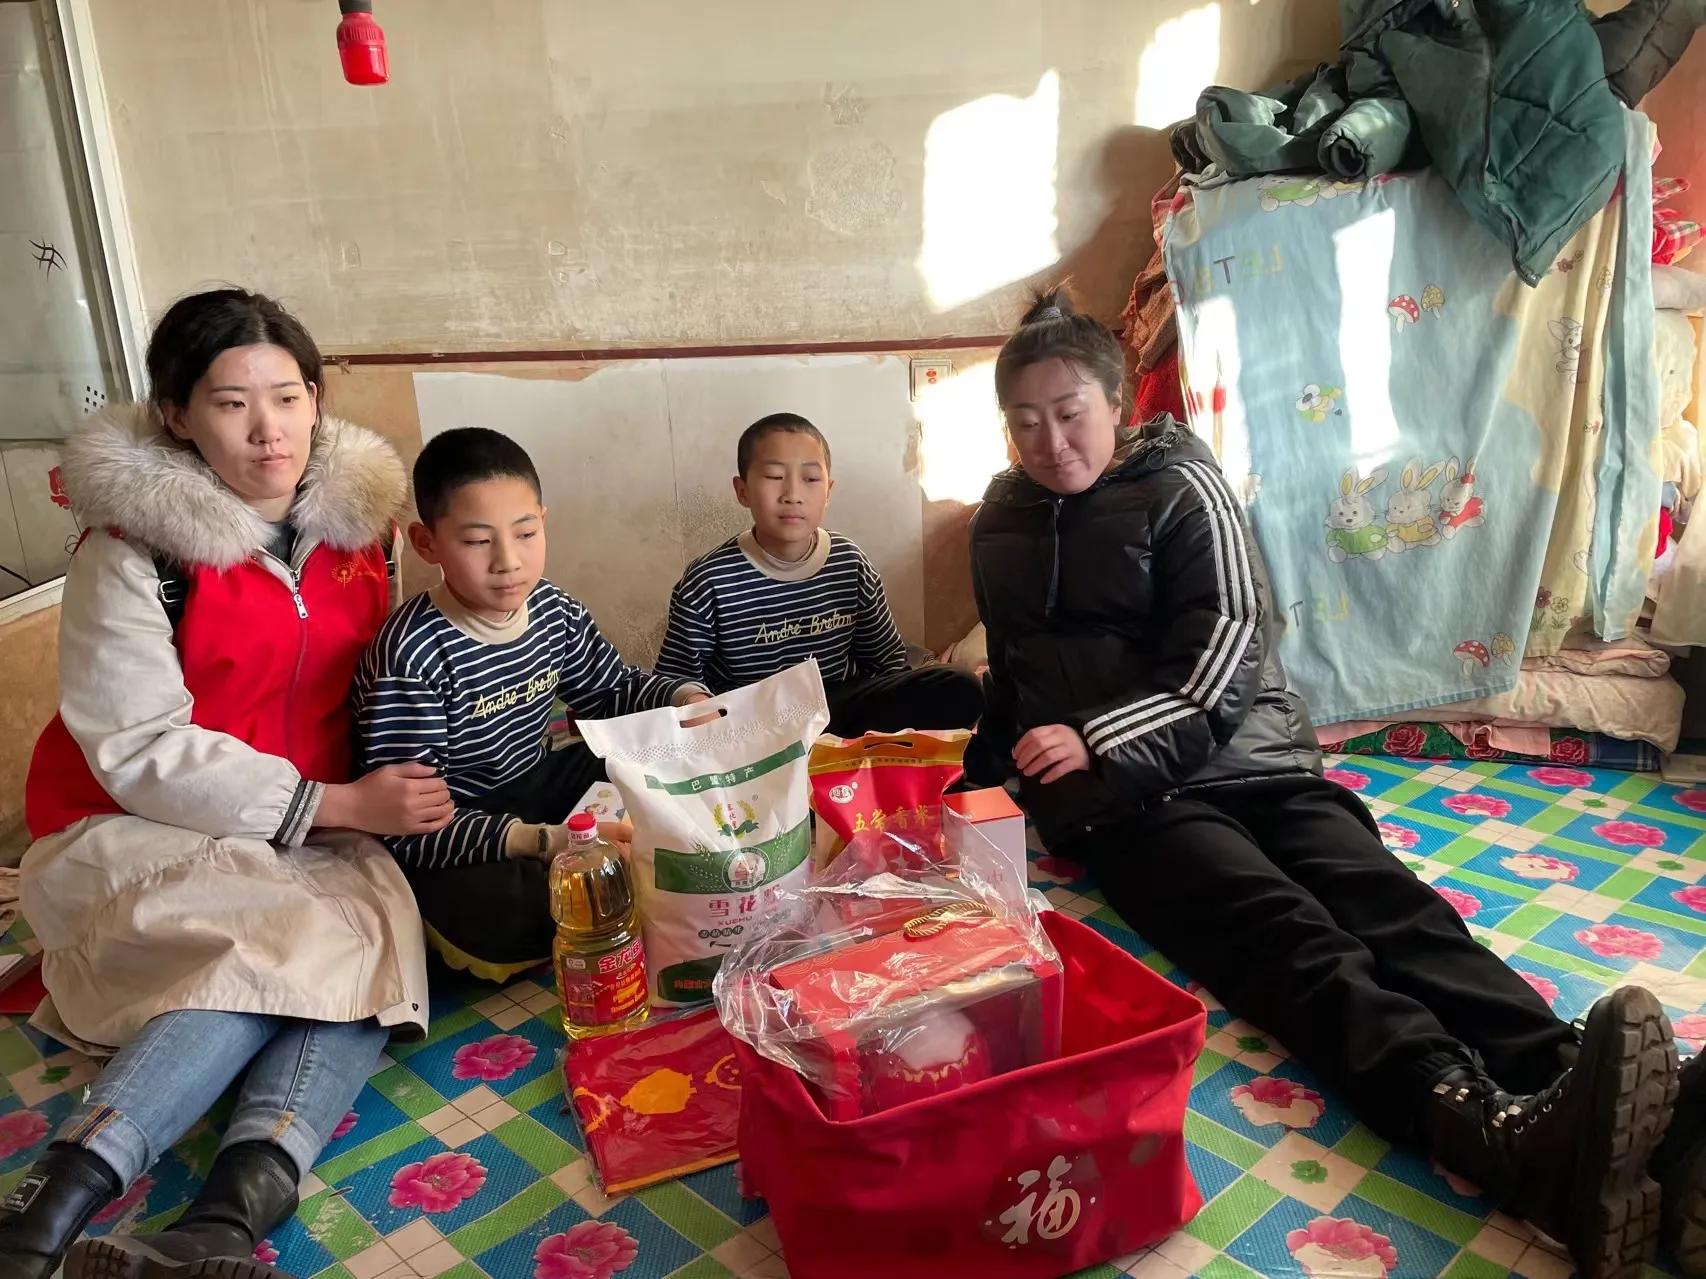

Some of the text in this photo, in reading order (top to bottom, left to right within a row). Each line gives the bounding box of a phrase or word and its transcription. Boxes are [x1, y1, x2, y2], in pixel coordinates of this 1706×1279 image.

[754, 617, 802, 644] André
[471, 683, 519, 720] André
[691, 766, 754, 791] 巴盟特产
[852, 805, 928, 834] 五常香米
[598, 937, 643, 974] 金龙鱼
[999, 1155, 1081, 1245] 福
